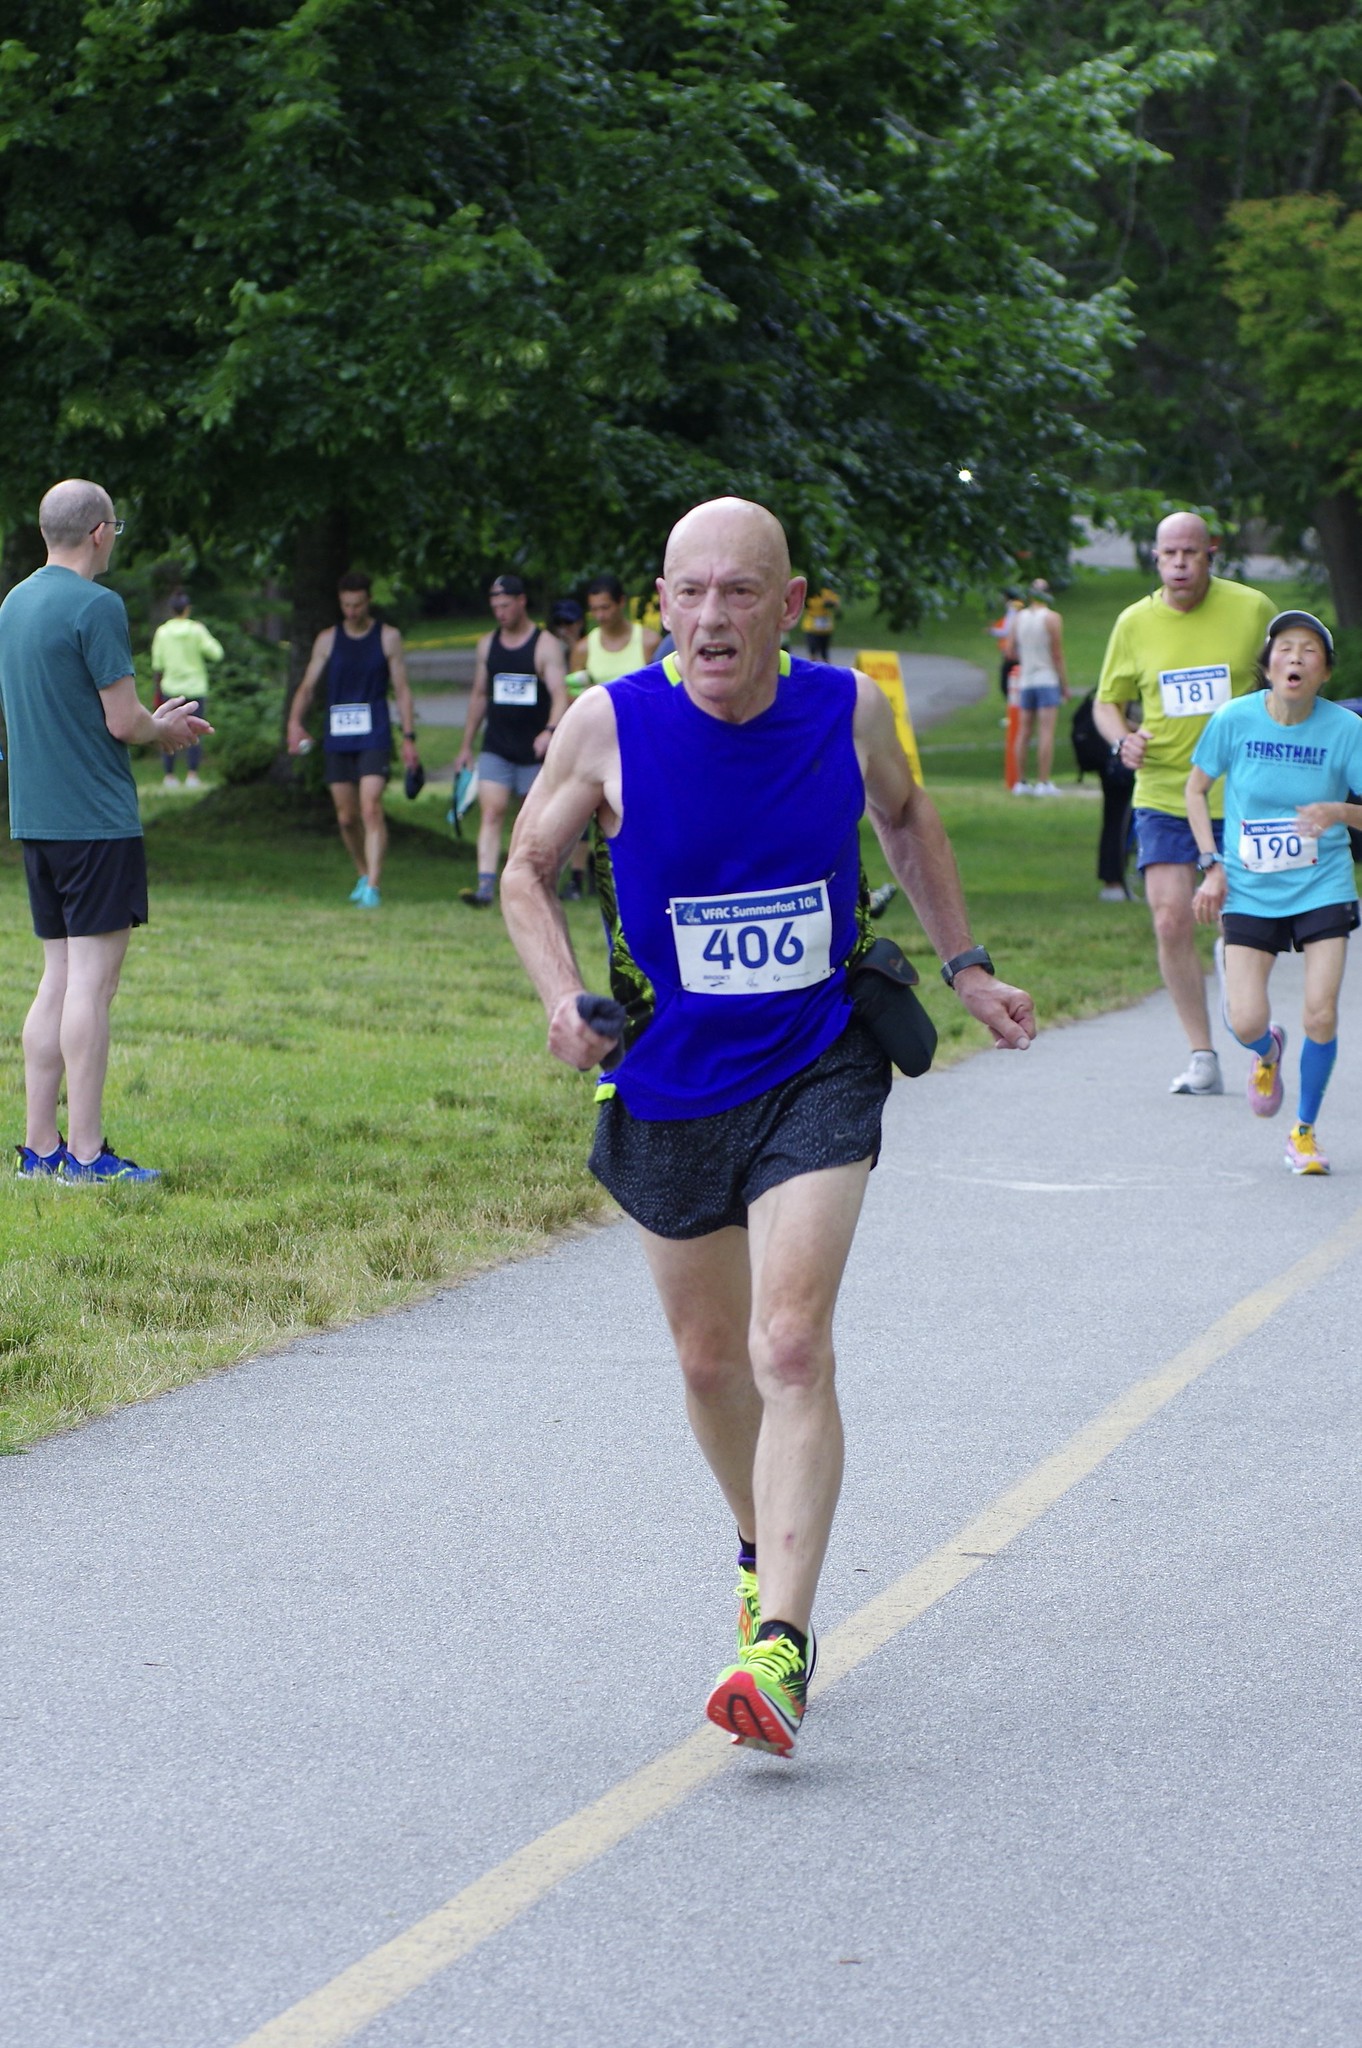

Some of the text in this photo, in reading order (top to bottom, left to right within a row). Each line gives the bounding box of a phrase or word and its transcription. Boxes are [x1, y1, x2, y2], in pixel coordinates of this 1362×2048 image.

[1175, 681, 1214, 704] 181
[1252, 835, 1302, 860] 190
[701, 895, 818, 920] VFAC Summerfast 10k
[702, 921, 805, 970] 406
